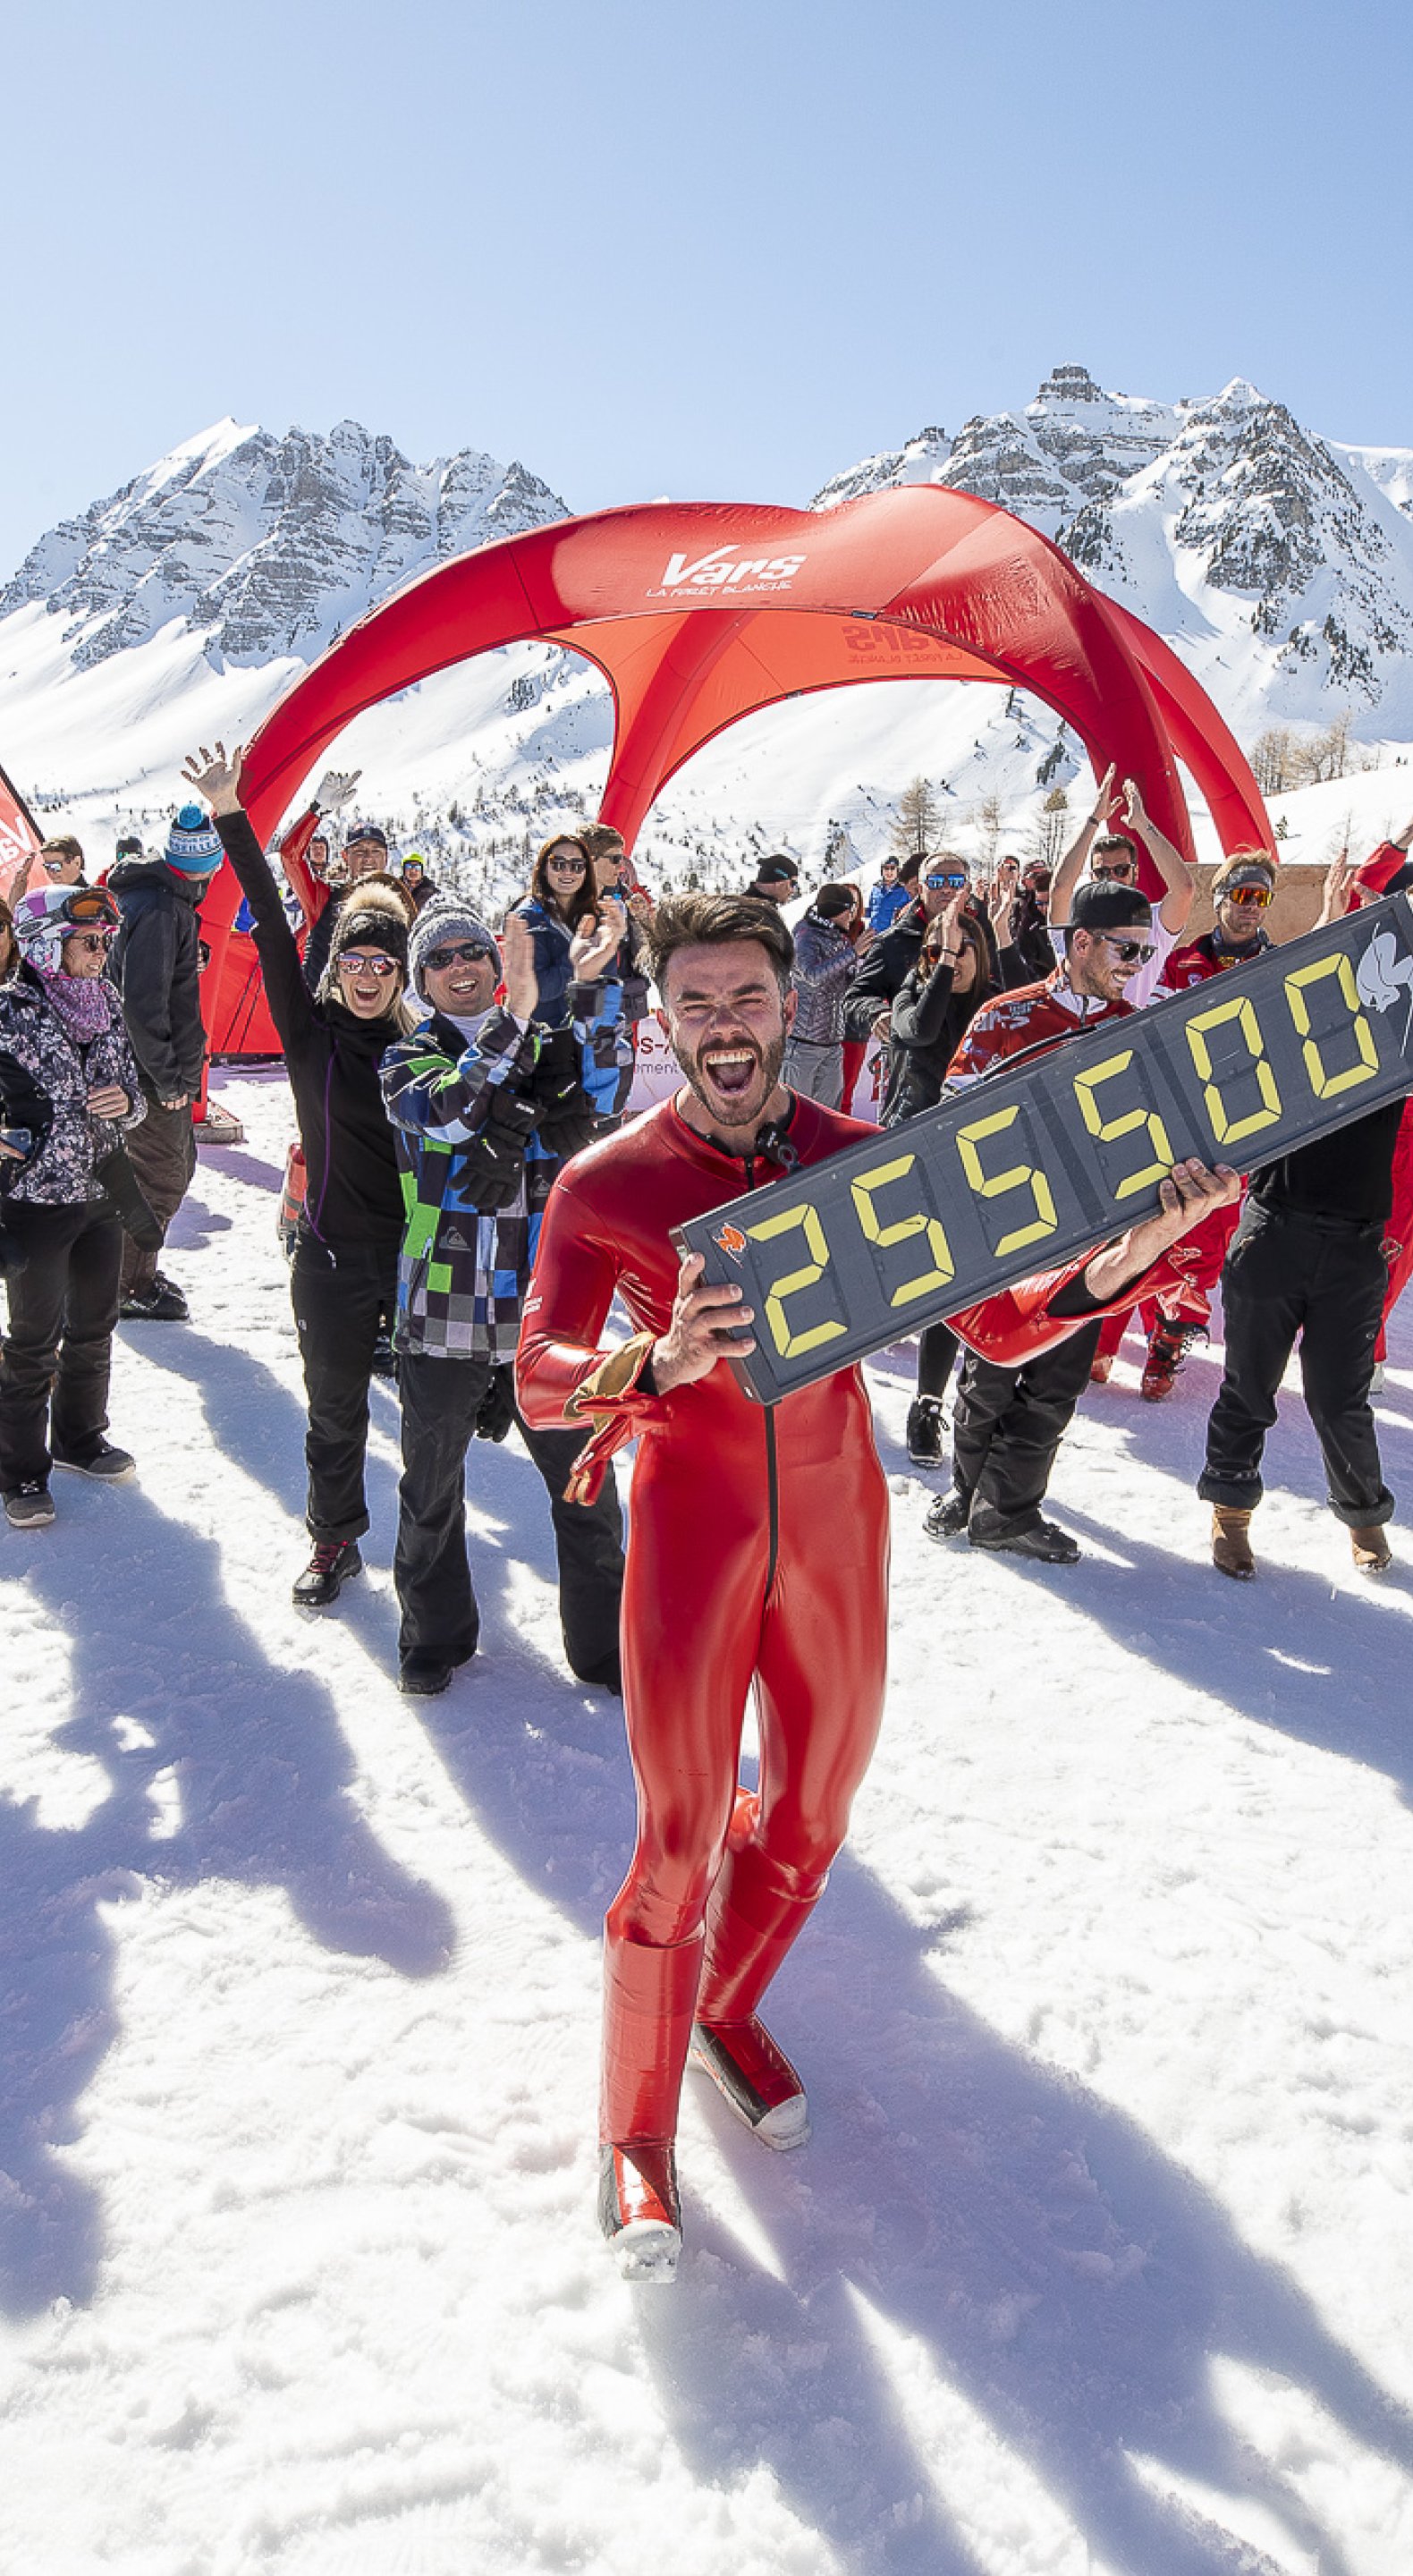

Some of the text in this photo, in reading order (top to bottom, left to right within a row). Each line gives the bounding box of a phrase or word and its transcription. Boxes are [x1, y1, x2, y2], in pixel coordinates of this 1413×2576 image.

[661, 544, 808, 587] Vars
[646, 587, 667, 598] LA
[722, 580, 793, 596] BLANCHE
